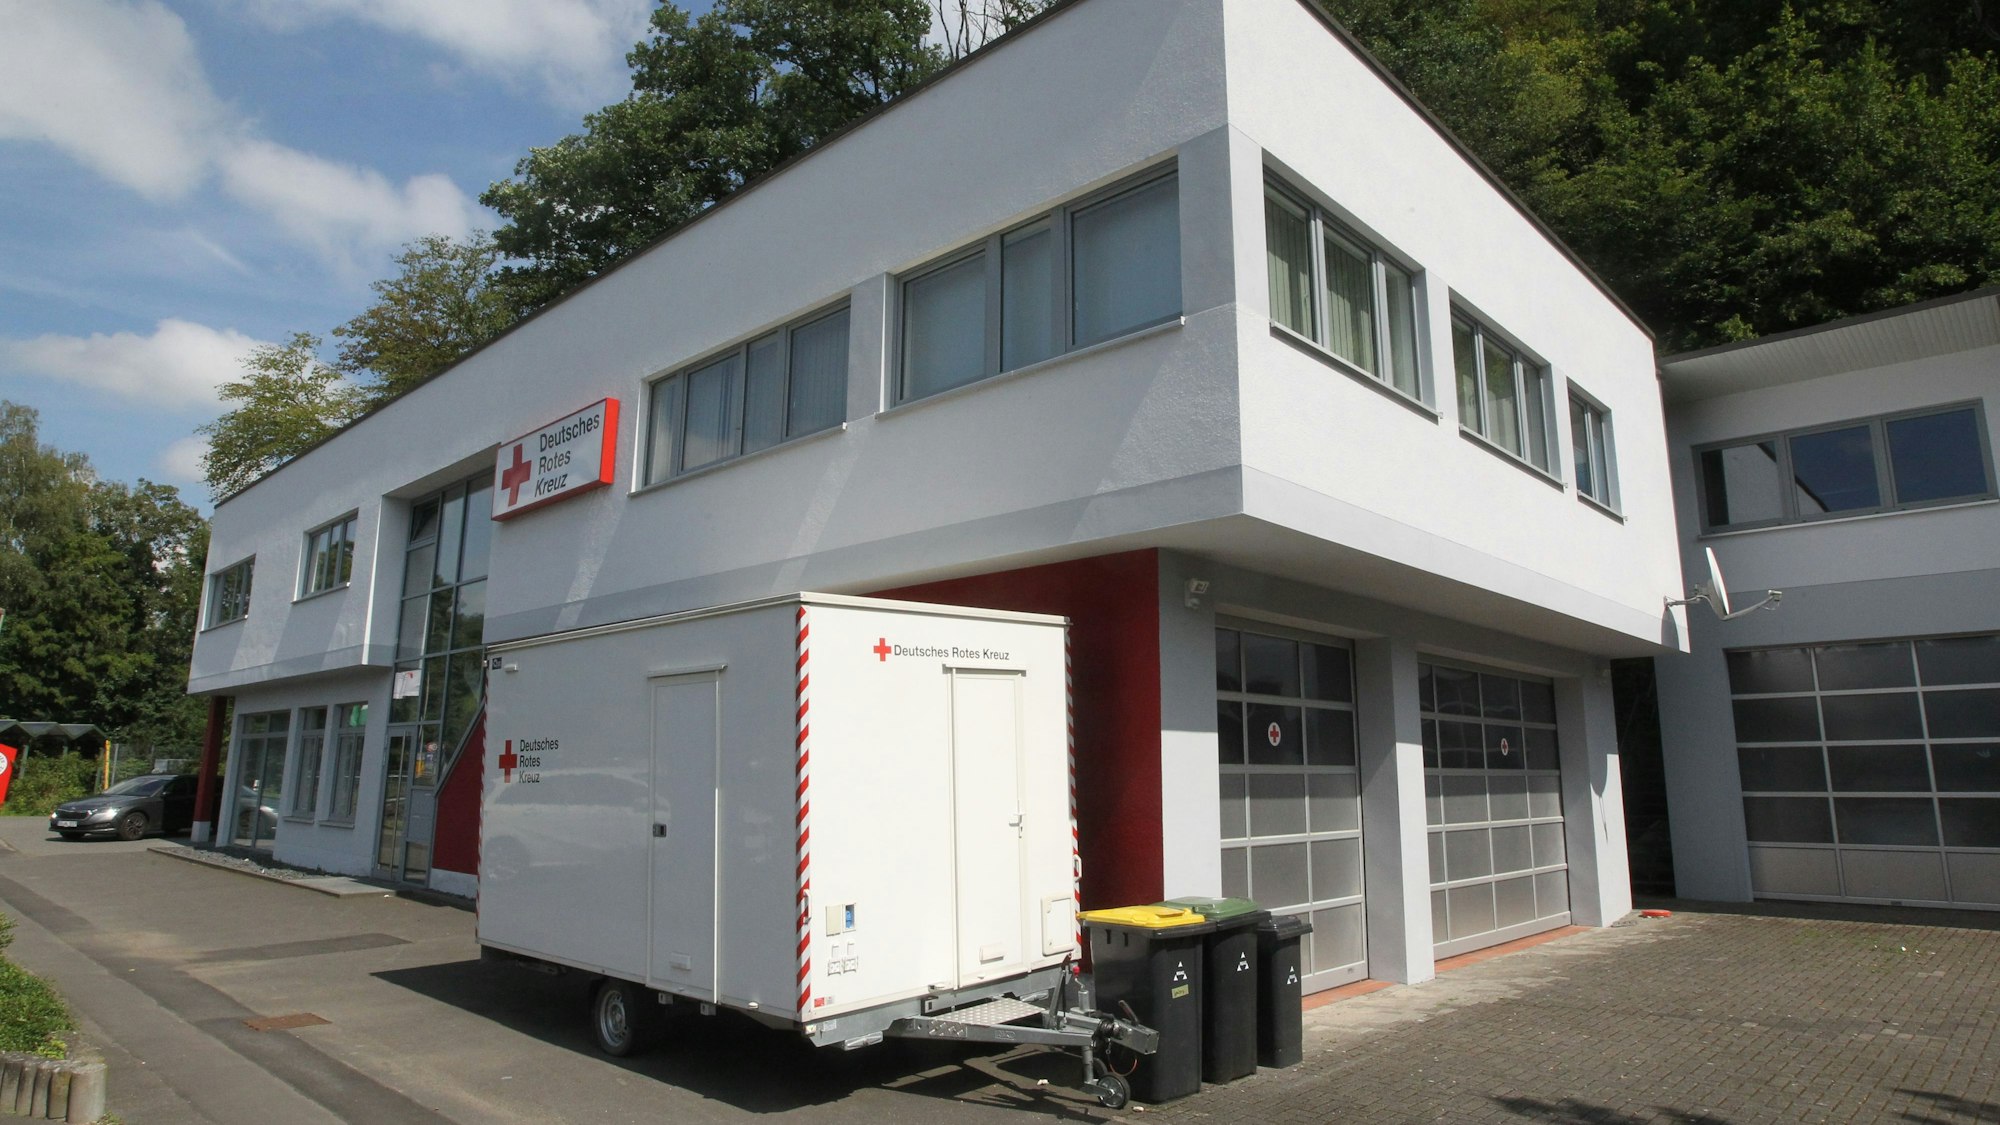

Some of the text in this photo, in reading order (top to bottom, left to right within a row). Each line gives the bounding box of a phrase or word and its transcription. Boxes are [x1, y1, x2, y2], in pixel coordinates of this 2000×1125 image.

[539, 413, 600, 453] Deutsches
[538, 450, 571, 475] Rotes
[534, 473, 568, 498] Kreuz
[893, 644, 1010, 661] Deutsches Rotes Kreuz
[519, 737, 559, 752] Deutsches
[519, 755, 541, 768] Rotes
[519, 770, 540, 784] Kreuz
